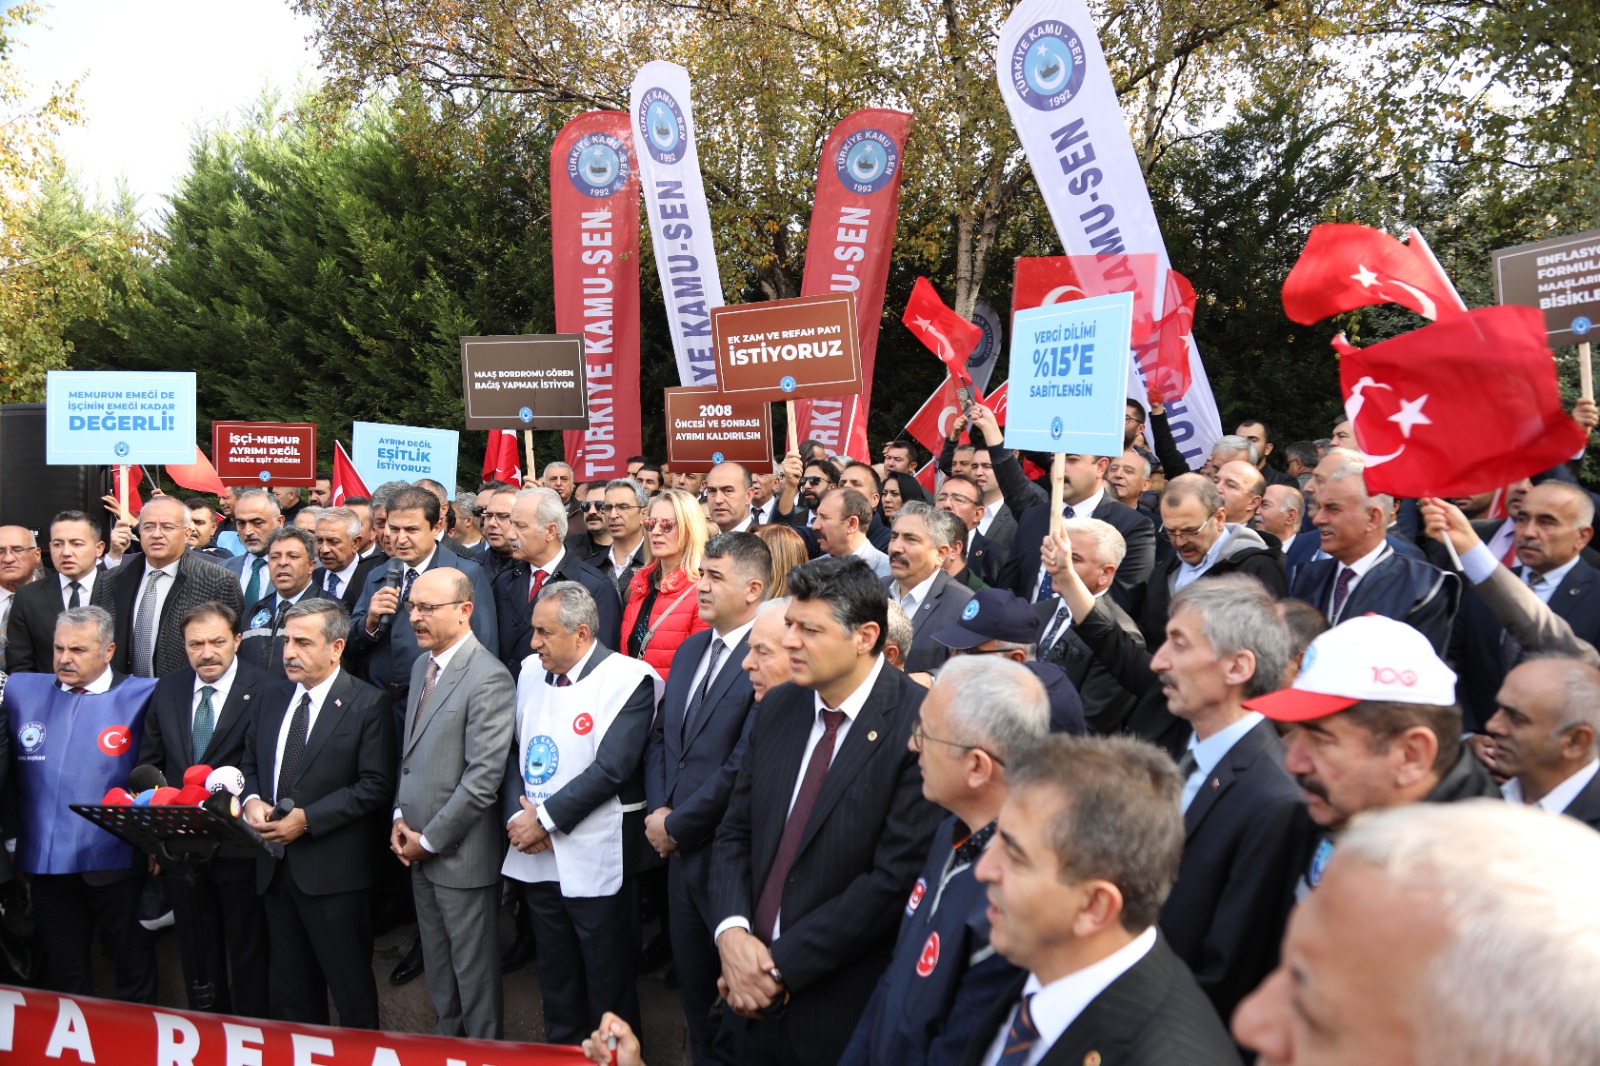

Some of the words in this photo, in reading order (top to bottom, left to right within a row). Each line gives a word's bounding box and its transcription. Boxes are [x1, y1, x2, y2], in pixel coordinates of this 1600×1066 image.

[1028, 23, 1063, 41] KAMU
[1068, 37, 1083, 66] SEN
[1048, 89, 1072, 107] 1992
[652, 90, 674, 108] KAMU
[676, 116, 686, 140] SEN
[591, 135, 620, 150] KAMU
[619, 155, 628, 177] SEN
[659, 152, 676, 162] 1992
[865, 131, 891, 147] KAMU
[885, 154, 896, 175] SEN
[590, 188, 610, 196] 1992
[853, 183, 872, 192] 1992
[655, 181, 712, 338] KAMU-SEN
[1537, 259, 1600, 280] FORMUL
[582, 211, 614, 354] KAMU-SEN
[1538, 274, 1600, 293] MAAŞLARI
[727, 336, 741, 344] EK
[743, 333, 765, 343] ZAM
[766, 331, 780, 341] VE
[782, 327, 815, 339] REFAH
[817, 325, 841, 335] PAYI
[1034, 324, 1062, 344] VERGİ
[1064, 320, 1096, 340] DİLİMİ
[729, 340, 843, 366] İSTİYORUZ
[1033, 343, 1094, 378] %15'E
[474, 370, 497, 379] MAAŞ
[498, 370, 544, 378] BORDROMU
[545, 368, 574, 377] GÖREN
[475, 380, 500, 391] BAĞIŞ
[502, 381, 539, 389] YAPMAK
[541, 379, 575, 388] İSTİYOR
[1030, 379, 1093, 398] SABİTLENSİN
[68, 391, 123, 399] MEMURUN
[125, 389, 158, 399] EMEĞİ
[160, 391, 175, 399] DE
[68, 401, 105, 411] İŞÇİNİN
[107, 401, 138, 410] EMEĞİ
[699, 404, 732, 417] 2008
[69, 411, 175, 431] DEĞERLİ!
[675, 418, 706, 428] ÖNCESİ
[707, 420, 719, 428] VE
[720, 419, 760, 427] SONRASI
[378, 437, 405, 446] AYRIM
[407, 439, 432, 449] DEĞİL
[675, 432, 705, 440] AYRIMI
[706, 432, 761, 440] KALDIRILSIN
[229, 447, 267, 455] AYRIMI
[269, 446, 301, 455] DEĞİL
[377, 446, 431, 462] EŞİTLİK
[256, 456, 272, 464] EŞİT
[377, 459, 431, 474] İSTİYORUZ!
